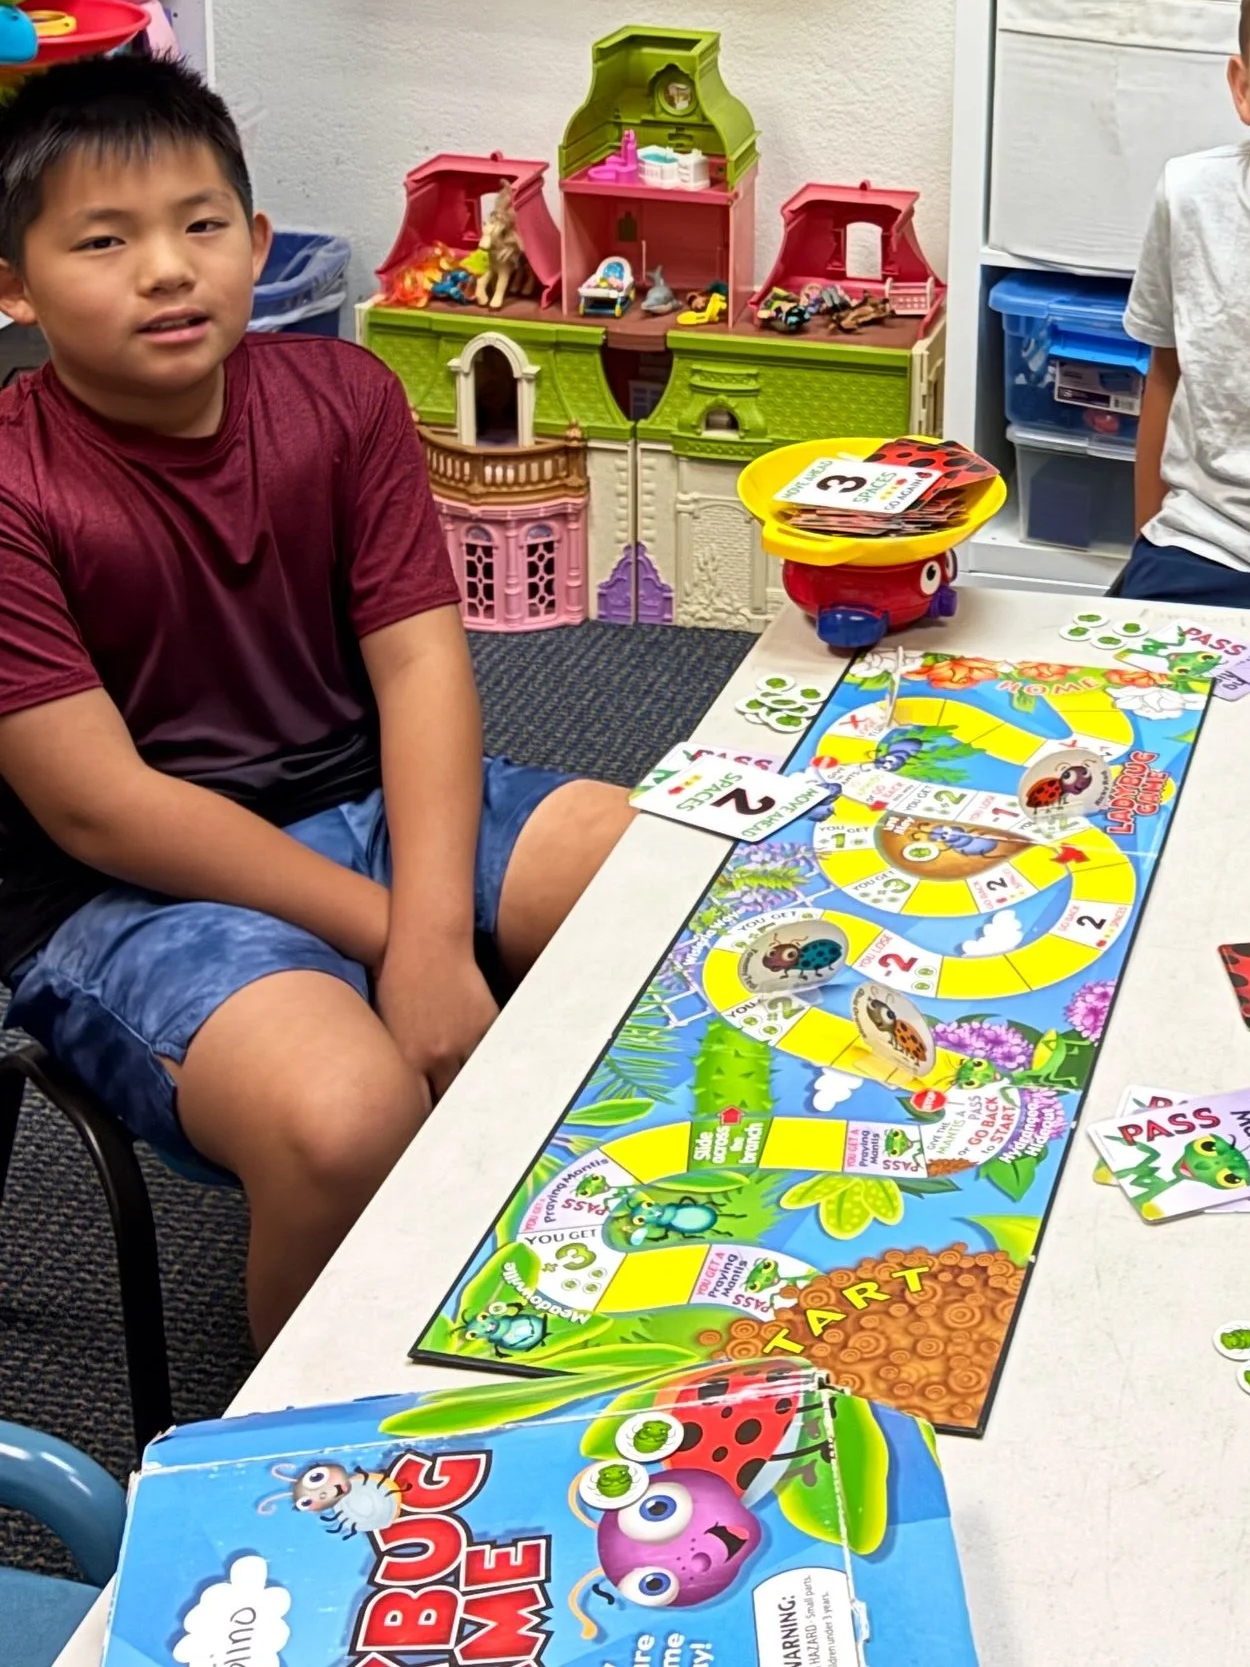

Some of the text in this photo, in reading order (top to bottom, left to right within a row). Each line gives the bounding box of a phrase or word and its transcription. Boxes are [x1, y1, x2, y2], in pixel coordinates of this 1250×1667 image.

[816, 474, 868, 494] 3
[852, 471, 898, 504] SPACES
[884, 478, 923, 511] GO AGAIN
[1181, 626, 1248, 657] PASS
[996, 676, 1101, 696] HOME
[676, 772, 743, 812] SPACES
[709, 787, 776, 816] 2
[1106, 750, 1159, 834] LADYBUG
[1135, 770, 1169, 816] GAME
[740, 787, 820, 837] MOVE AHEAD
[853, 870, 897, 891] YOU GET
[985, 876, 1009, 892] 2
[737, 910, 797, 932] YOU GET
[1076, 914, 1107, 931] 2
[857, 934, 895, 969] YOU LOSE
[878, 953, 919, 977] -2
[726, 1002, 756, 1019] YOU
[967, 1095, 982, 1121] PASS
[967, 1128, 990, 1147] GO
[981, 1096, 999, 1129] BACK
[738, 1121, 765, 1164] branch
[848, 1134, 859, 1151] GET
[926, 1135, 940, 1151] GIVE
[938, 1119, 966, 1155] MANTIS
[980, 1104, 1017, 1156] to START
[1117, 1107, 1222, 1147] PASS
[693, 1131, 714, 1161] Slide
[846, 1150, 856, 1168] YOU
[859, 1129, 871, 1167] Praying
[869, 1132, 881, 1165] Mantis
[882, 1159, 919, 1173] PASS
[544, 1158, 610, 1224] Praying Mantis
[561, 1198, 610, 1217] PASS
[525, 1228, 597, 1245] YOU GET
[696, 1279, 710, 1296] YOU
[703, 1261, 720, 1282] GET
[707, 1252, 739, 1298] Praying
[721, 1259, 748, 1298] Mantis
[502, 1261, 592, 1325] Meadowville
[731, 1293, 770, 1314] PASS
[763, 1266, 930, 1355] TART
[350, 1449, 493, 1667] BUG
[453, 1534, 554, 1667] ME
[820, 1590, 834, 1615] years.
[802, 1574, 821, 1665] HAZARD Small parts.
[823, 1620, 837, 1646] under
[662, 1632, 685, 1667] me
